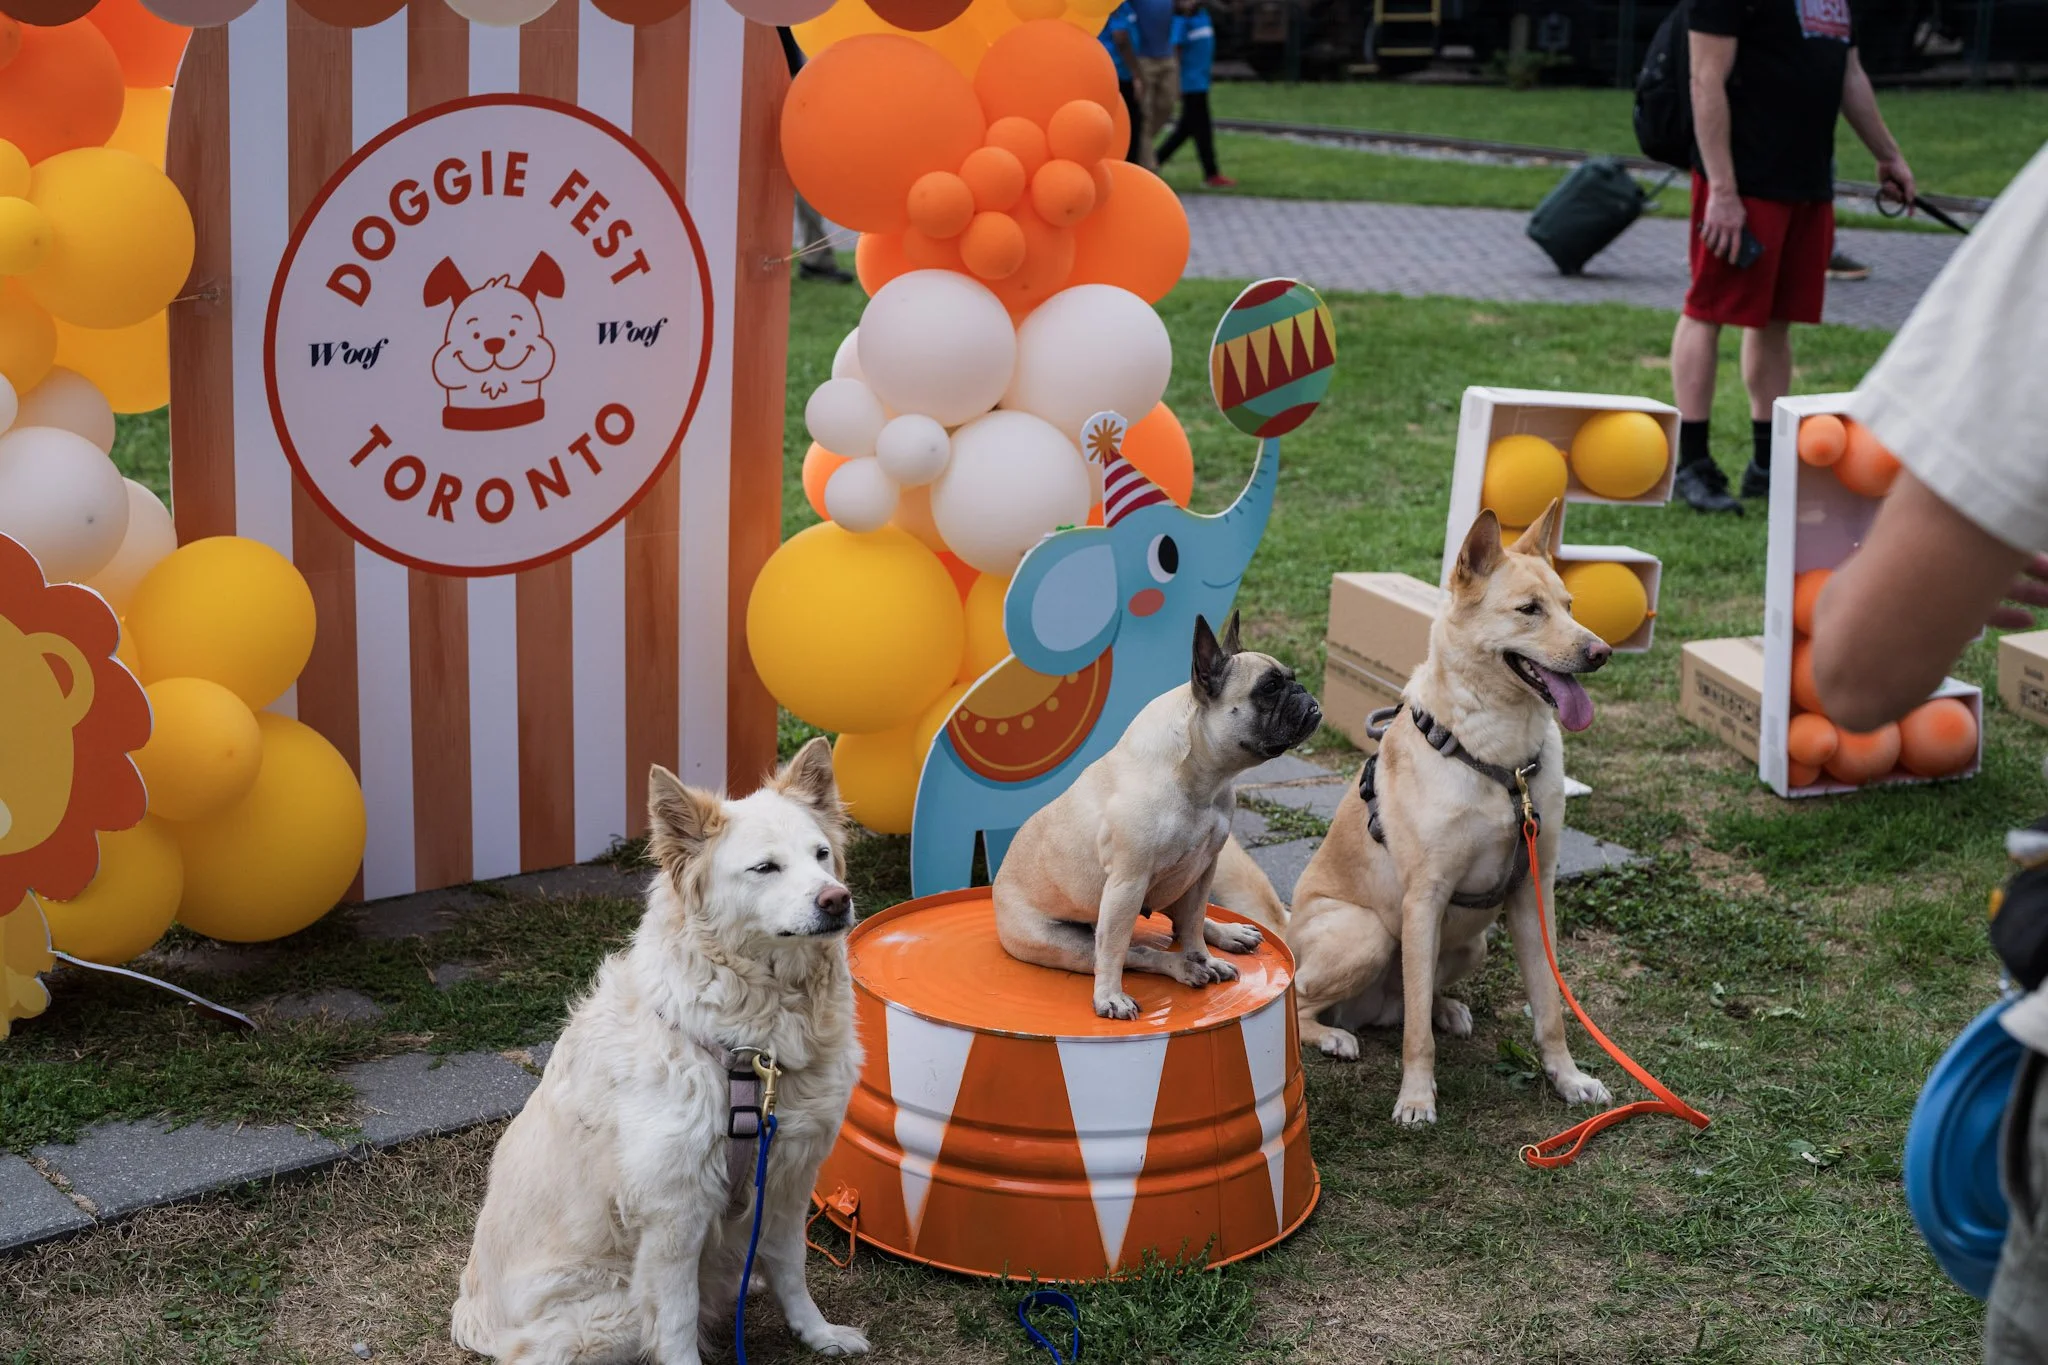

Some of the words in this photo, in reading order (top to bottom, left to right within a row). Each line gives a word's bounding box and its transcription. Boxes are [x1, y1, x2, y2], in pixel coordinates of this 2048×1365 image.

[326, 151, 528, 307] DOGGIE
[550, 170, 651, 284] FEST
[310, 338, 390, 370] Woof
[597, 317, 669, 347] Woof
[350, 403, 635, 524] TORONTO
